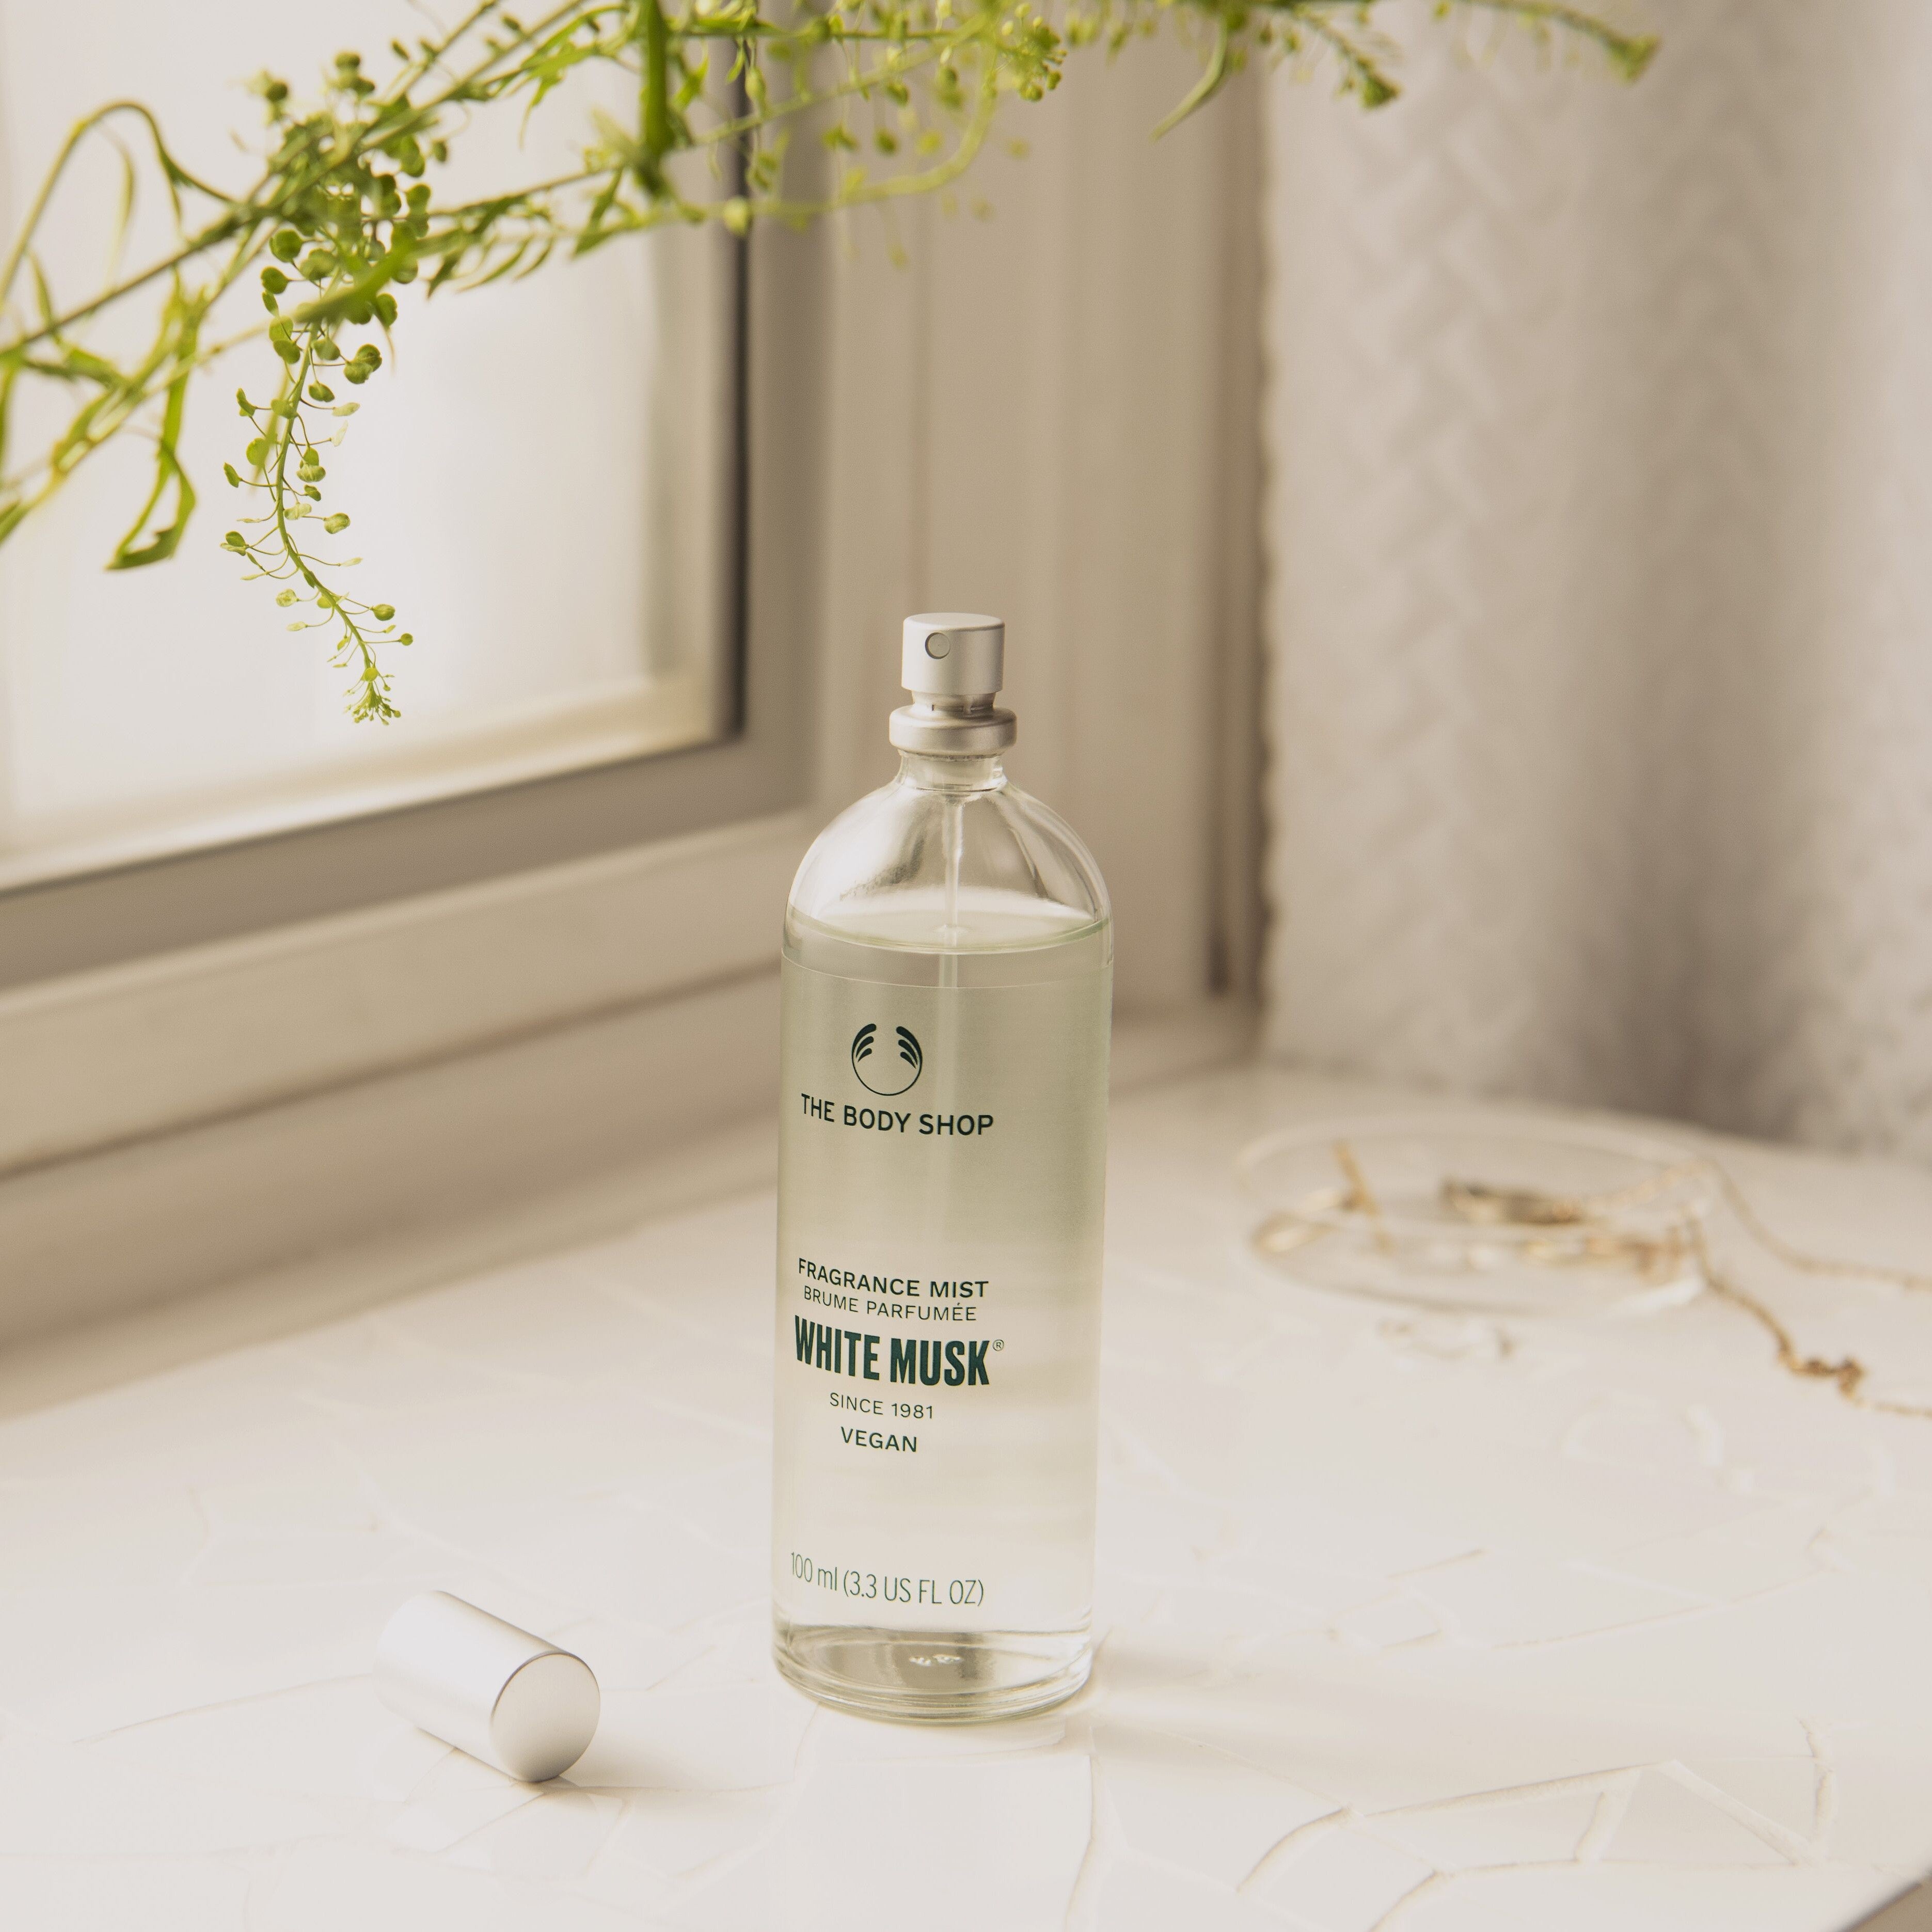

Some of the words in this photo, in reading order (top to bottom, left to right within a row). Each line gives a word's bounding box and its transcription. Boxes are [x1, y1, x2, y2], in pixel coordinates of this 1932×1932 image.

[801, 1092, 835, 1122] THE
[844, 1105, 911, 1133] BODY
[919, 1114, 993, 1135] SHOP
[799, 1258, 920, 1296] FRAGRANCE
[930, 1280, 989, 1298] MIST
[804, 1285, 859, 1312] BRUME
[867, 1301, 977, 1321] PARFUMÉE
[795, 1315, 880, 1381] WHITE
[830, 1392, 883, 1415] SINCE
[891, 1403, 932, 1419] 1981
[841, 1427, 917, 1452] VEGAN
[790, 1551, 813, 1582] 100
[817, 1566, 837, 1591] ml
[843, 1570, 877, 1598] (3.3
[884, 1576, 911, 1603] US
[919, 1579, 942, 1604] FL
[949, 1579, 984, 1607] OZ)
